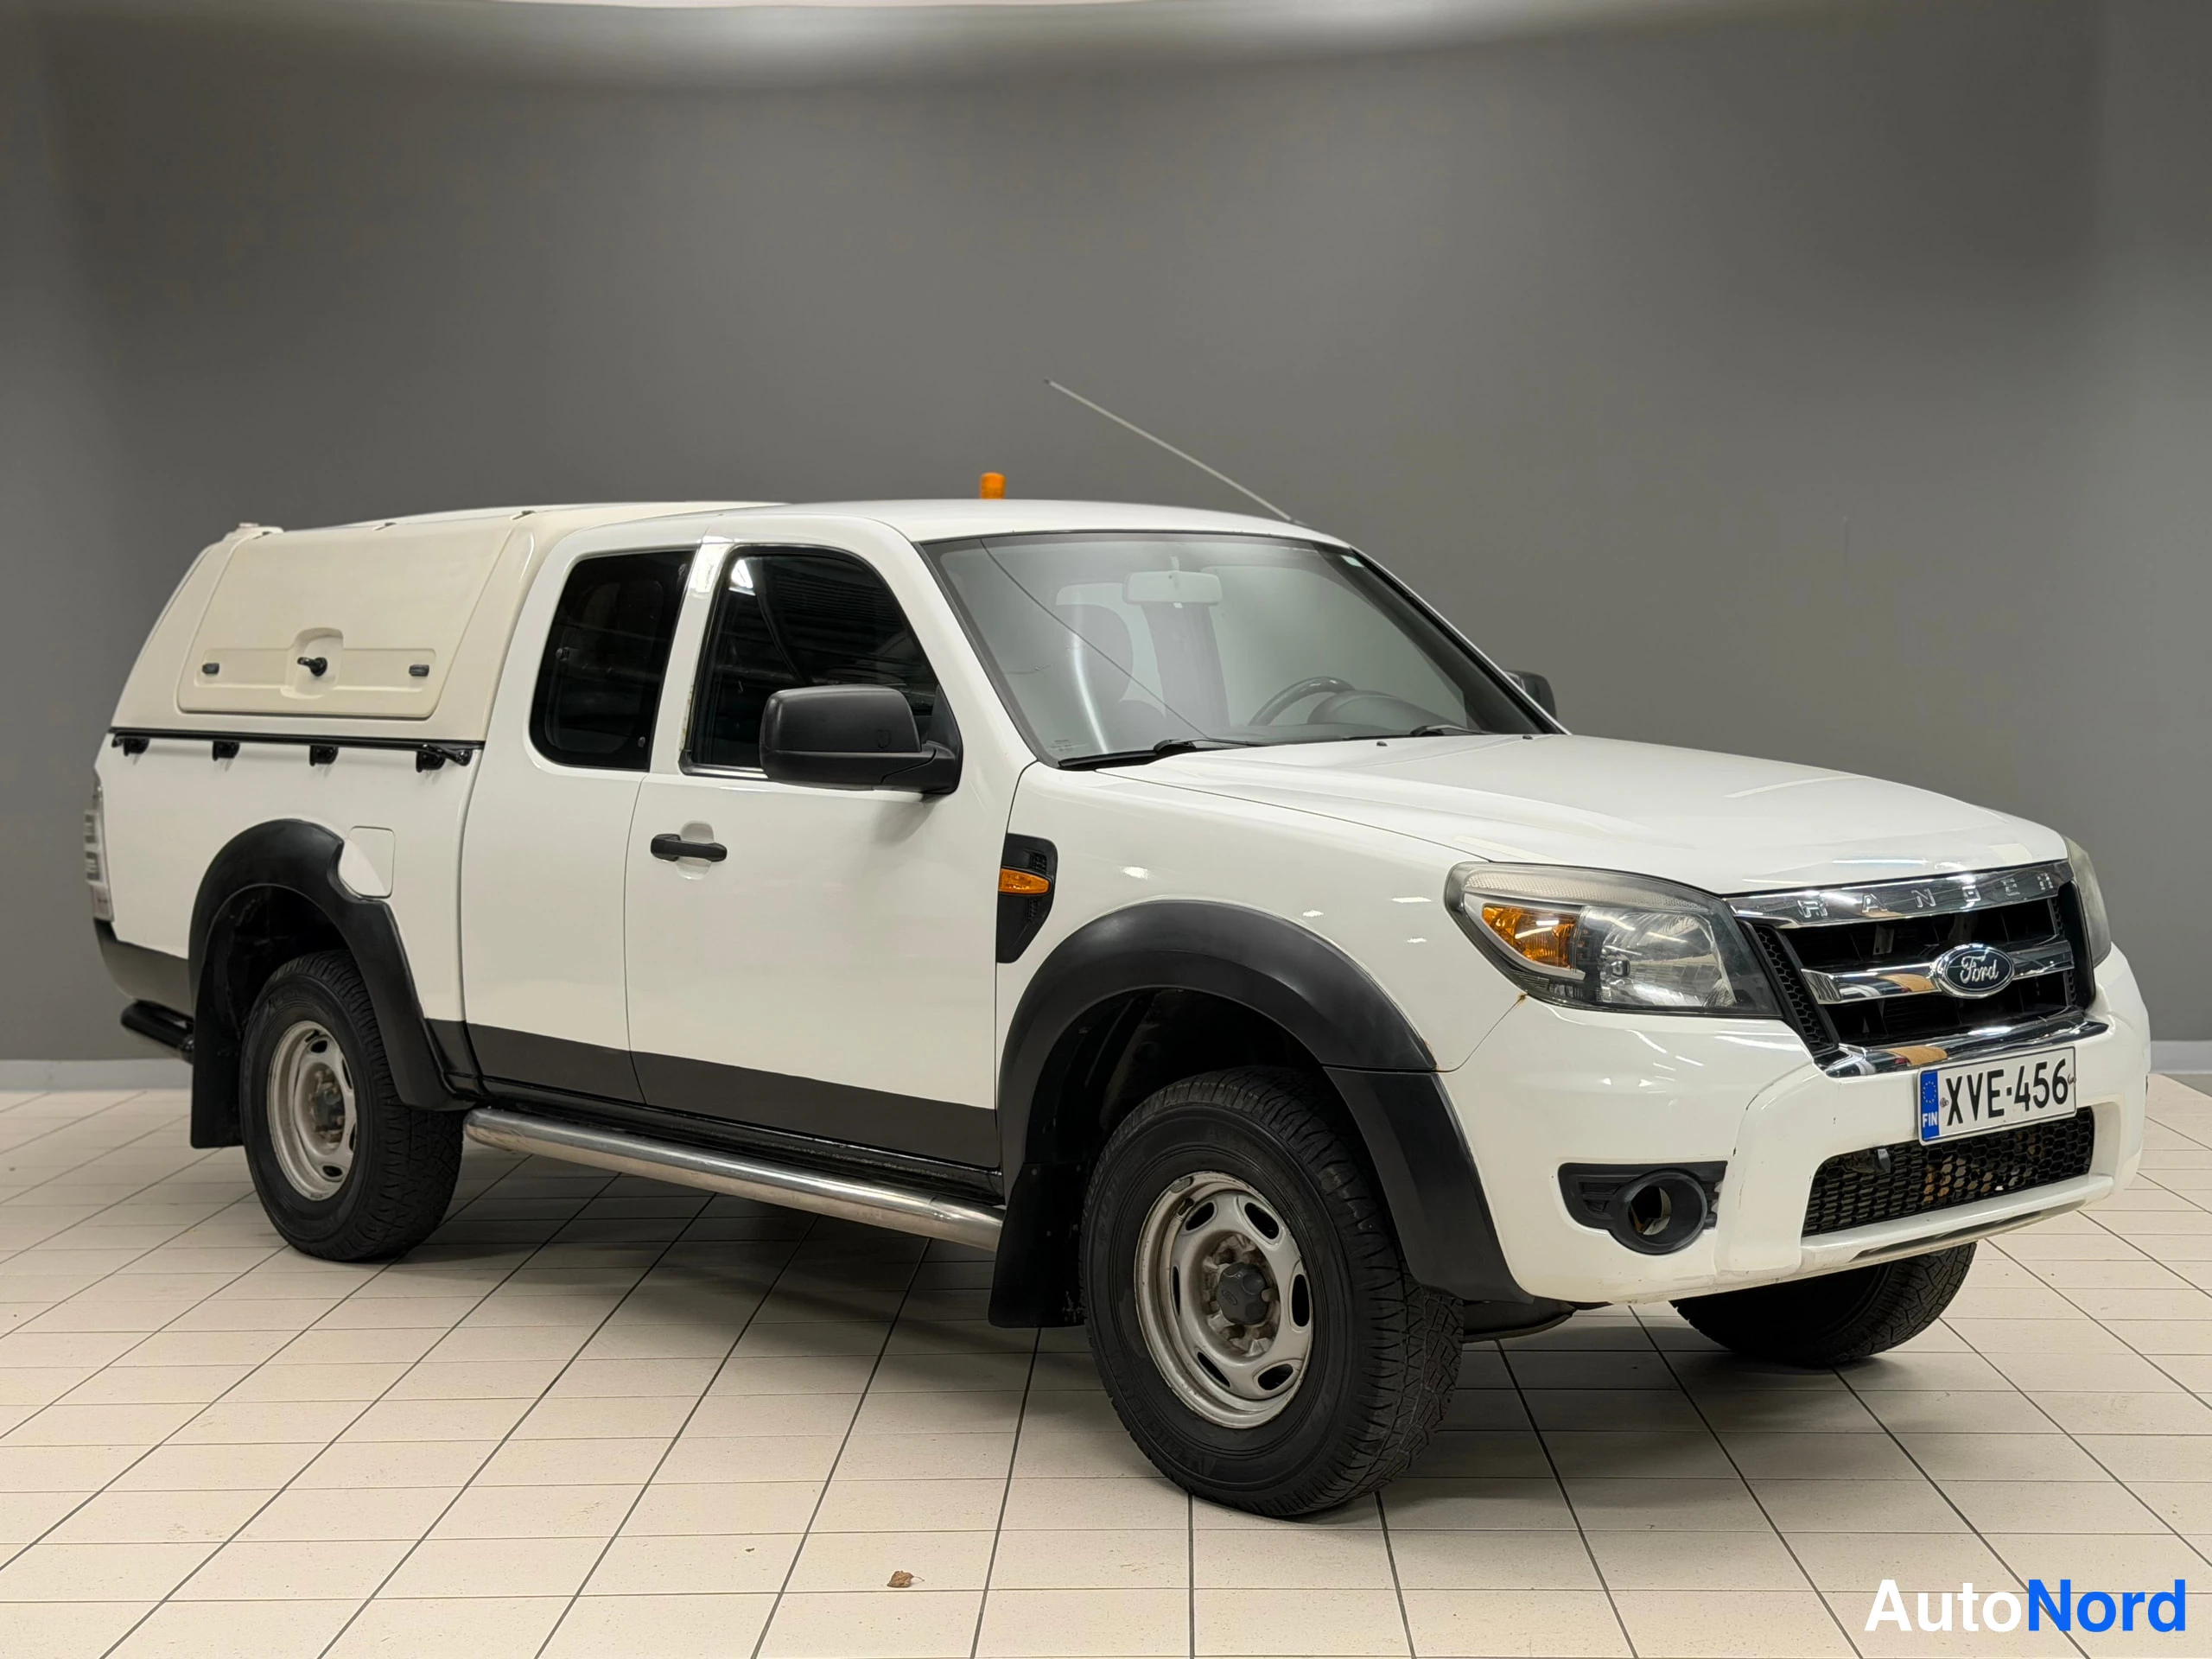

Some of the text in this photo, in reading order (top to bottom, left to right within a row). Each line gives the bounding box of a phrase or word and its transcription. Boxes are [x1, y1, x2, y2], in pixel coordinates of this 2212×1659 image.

[1796, 872, 2055, 918] RANGER
[1960, 955, 1999, 984] Ford
[1945, 1058, 2069, 1127] XVE-456
[1922, 1111, 1938, 1128] FIN
